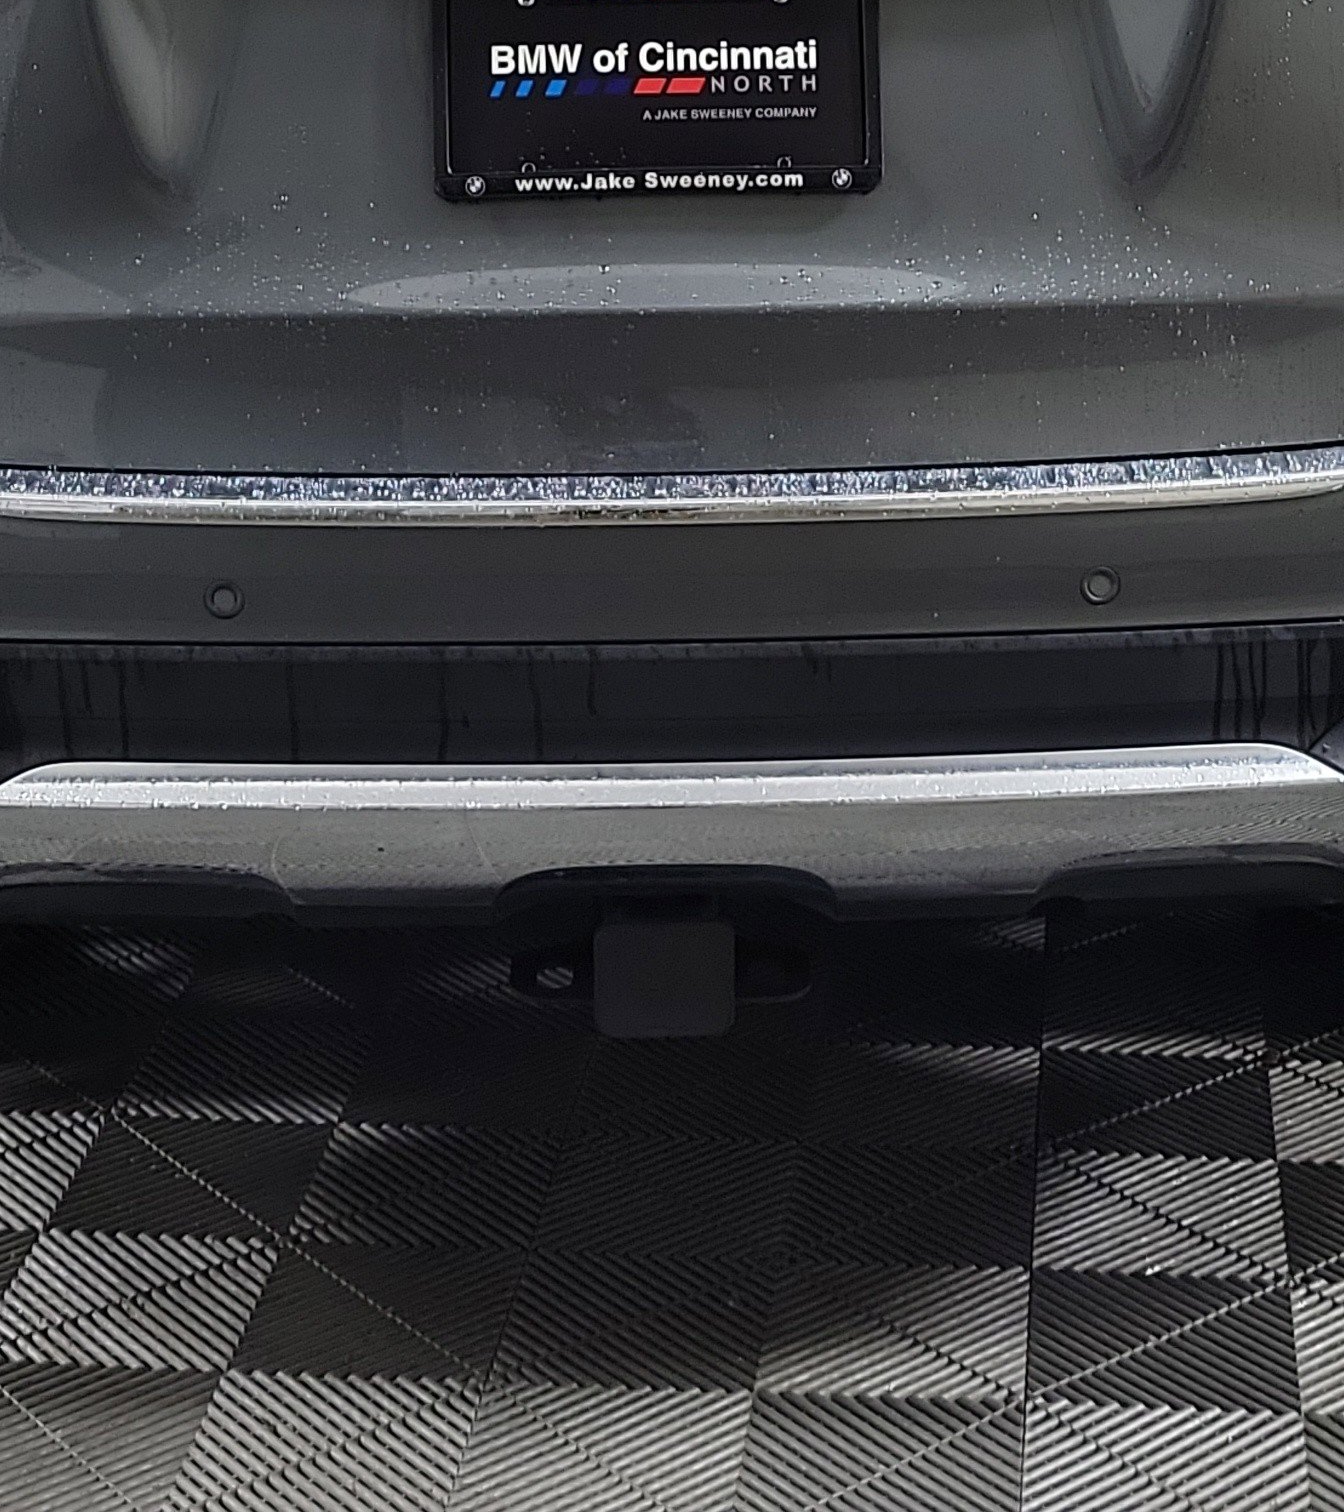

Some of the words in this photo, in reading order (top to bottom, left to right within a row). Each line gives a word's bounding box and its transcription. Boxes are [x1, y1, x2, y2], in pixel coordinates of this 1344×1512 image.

[490, 43, 583, 75] BMW
[592, 42, 629, 73] of
[638, 39, 818, 73] Cincinnati
[710, 74, 818, 94] NORTH
[642, 109, 653, 121] A
[654, 108, 688, 121] JAKE
[690, 107, 753, 120] SWEENEY
[754, 106, 818, 119] COMPANY
[514, 172, 636, 191] www.Jake
[643, 170, 804, 191] Sweeney.com
